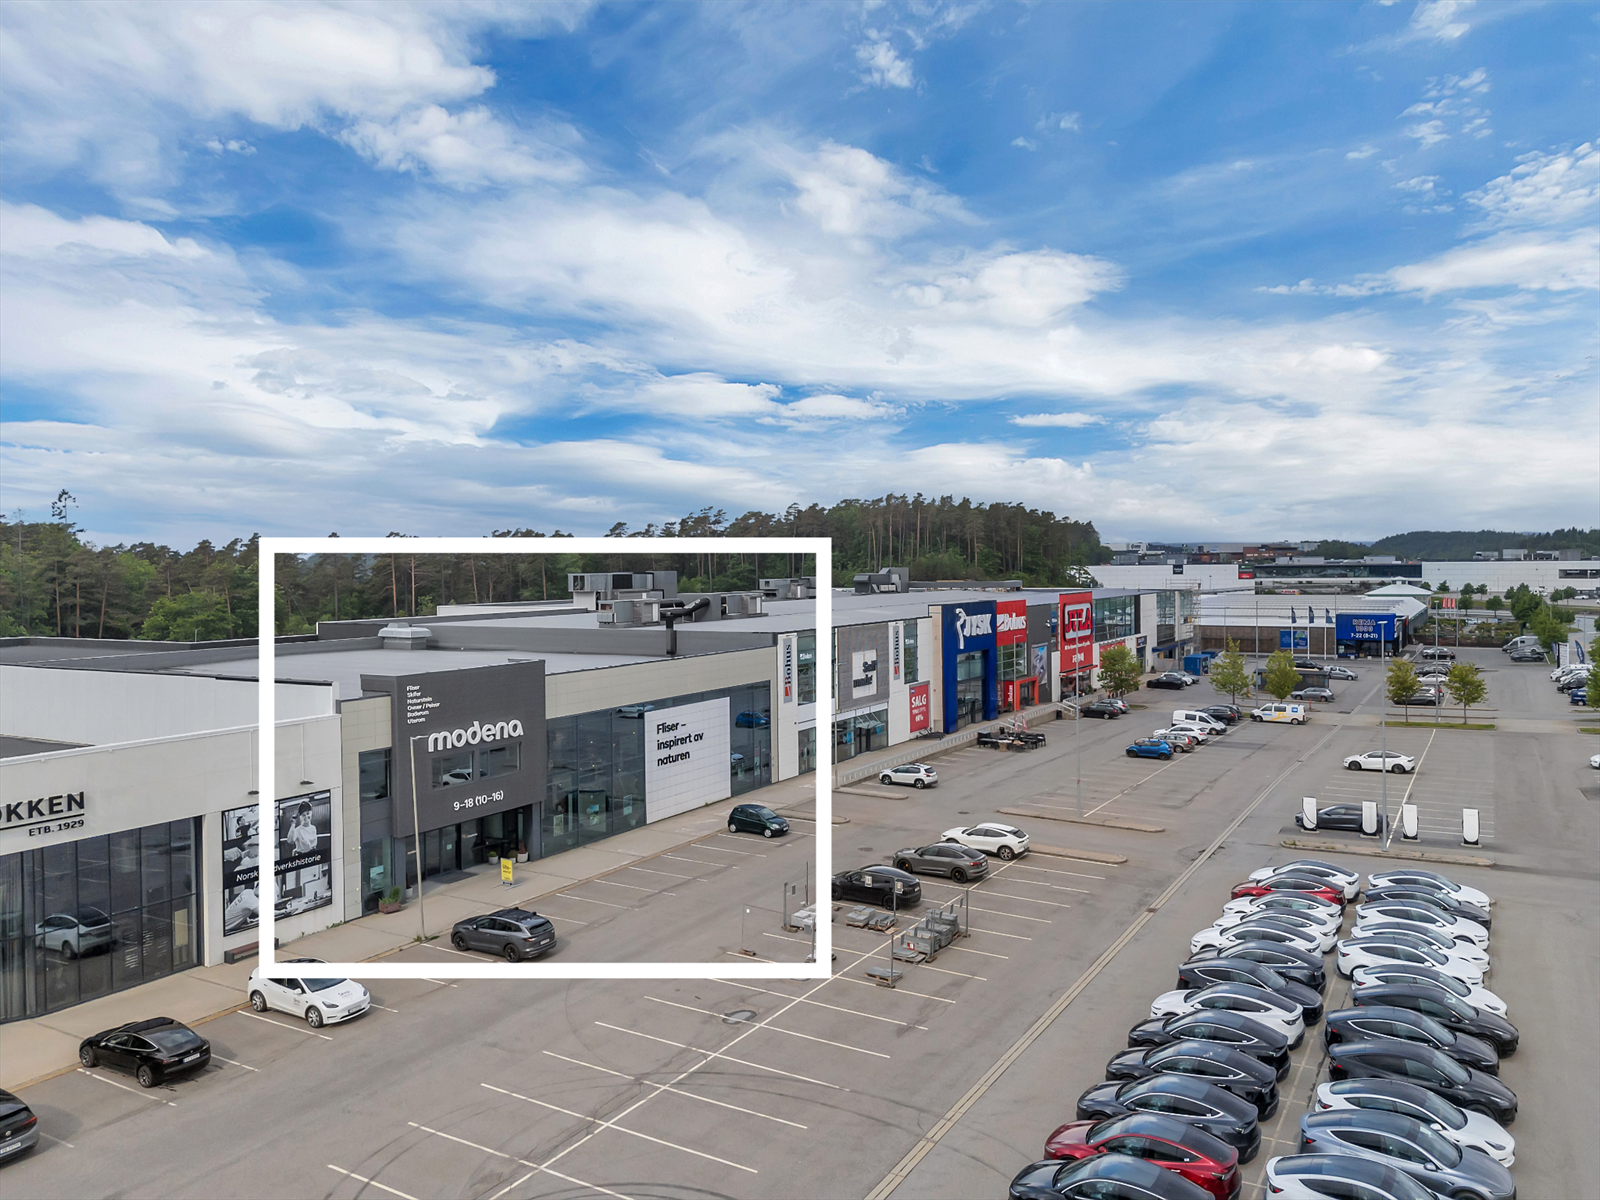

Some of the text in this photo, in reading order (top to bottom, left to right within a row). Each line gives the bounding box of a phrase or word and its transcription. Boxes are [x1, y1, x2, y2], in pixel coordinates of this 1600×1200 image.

[963, 613, 992, 637] JYSK
[1004, 612, 1026, 631] Bohus
[1065, 607, 1091, 633] JULA
[911, 694, 927, 708] SALG
[428, 719, 524, 752] modena
[656, 722, 679, 734] Fliser
[657, 733, 704, 750] inspirert av
[657, 751, 690, 766] naturen
[0, 791, 85, 823] KKEN
[28, 819, 85, 836] ETB. 1929
[236, 870, 259, 882] Norsk
